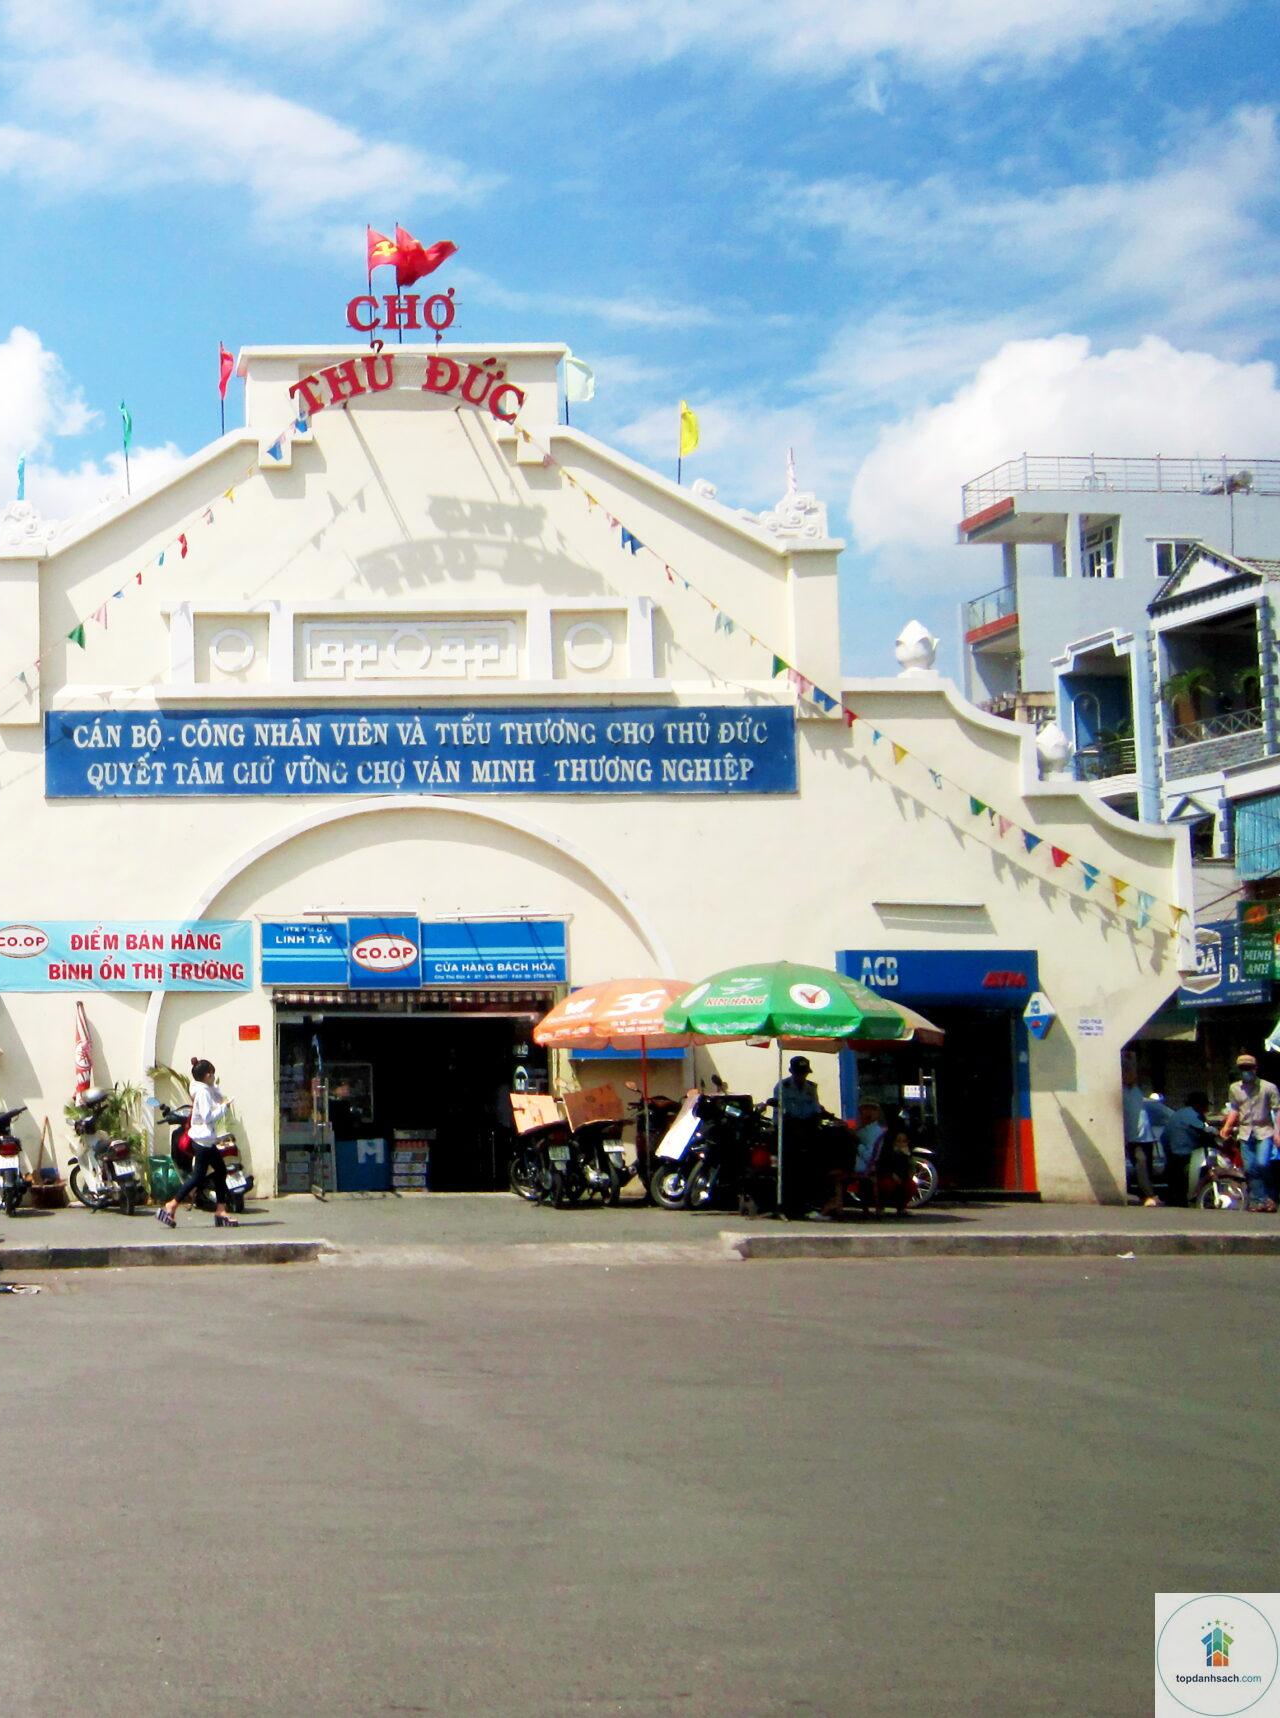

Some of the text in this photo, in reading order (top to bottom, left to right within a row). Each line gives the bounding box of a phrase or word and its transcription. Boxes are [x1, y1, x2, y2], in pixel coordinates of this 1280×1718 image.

[346, 287, 456, 341] CHỢ
[289, 340, 525, 424] THỦ ĐỨC
[73, 718, 121, 748] CÁN
[131, 719, 162, 752] BỘ
[181, 718, 245, 747] CÔNG
[254, 718, 321, 746] NHÂN
[331, 717, 388, 746] VIÊN
[396, 717, 426, 746] VÀ
[435, 713, 491, 746] TIỂU
[500, 718, 596, 746] THƯƠNG
[663, 713, 711, 745] THỦ
[719, 715, 768, 745] ĐỨC
[87, 752, 167, 791] QUYẾT
[173, 757, 224, 785] TÂM
[285, 755, 348, 785] VỮNG
[357, 758, 406, 789] CHỢ
[472, 760, 536, 783] MINH
[554, 755, 653, 783] THƯƠNG
[661, 752, 755, 786] NGHIỆP
[70, 924, 221, 951] ĐIỂM BÁN HÀNG
[275, 934, 332, 944] LINH TÂY
[356, 947, 413, 960] CO.OP
[434, 962, 458, 972] CỬA
[461, 962, 494, 972] HÀNG
[497, 962, 528, 971] BÁCH
[48, 955, 244, 983] BÌNH ỔN THỊ TRƯỜNG
[861, 957, 899, 987] ACB
[606, 989, 666, 1017] 3G
